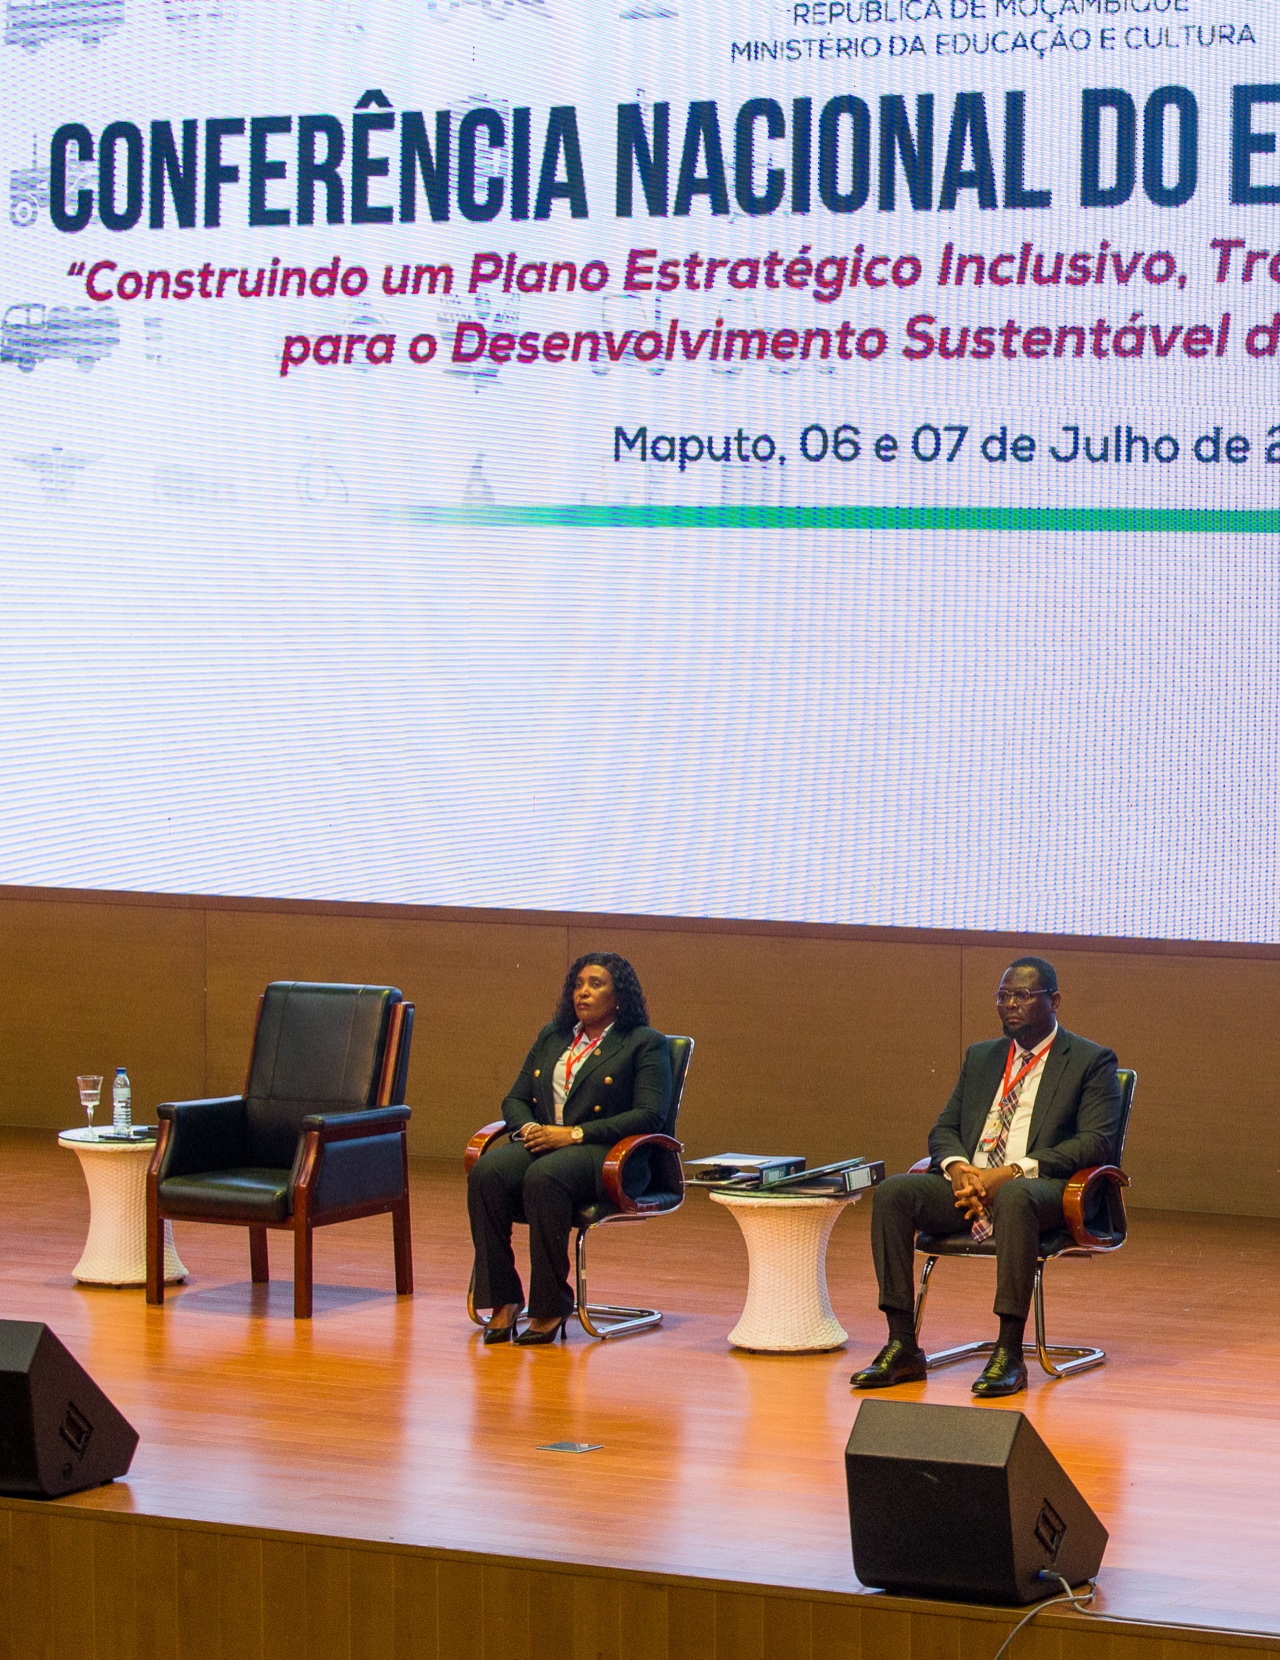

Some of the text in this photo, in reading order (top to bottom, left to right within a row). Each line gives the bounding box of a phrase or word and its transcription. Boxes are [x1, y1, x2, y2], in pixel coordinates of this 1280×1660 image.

[951, 0, 986, 19] DE
[731, 23, 1257, 63] MINISTÉRIO DA EDUCAÇÃO E CULTURA
[48, 89, 589, 233] CONFERÊNCIA
[615, 90, 1052, 218] NACIONAL
[1080, 86, 1199, 208] DO
[67, 256, 369, 302] “Construindo
[382, 264, 454, 297] um
[468, 252, 610, 294] Plano
[624, 243, 922, 303] Estratégico
[937, 239, 1188, 289] Inclusivo,
[280, 332, 396, 377] para
[408, 333, 438, 365] o
[452, 318, 887, 364] Desenvolvimento
[902, 311, 1230, 361] Sustentável
[613, 425, 787, 472] Maputo,
[800, 423, 862, 463] 06
[873, 432, 899, 463] e
[911, 423, 969, 463] 07
[981, 425, 1037, 463] de
[1049, 425, 1181, 463] Julho
[1192, 426, 1251, 464] de
